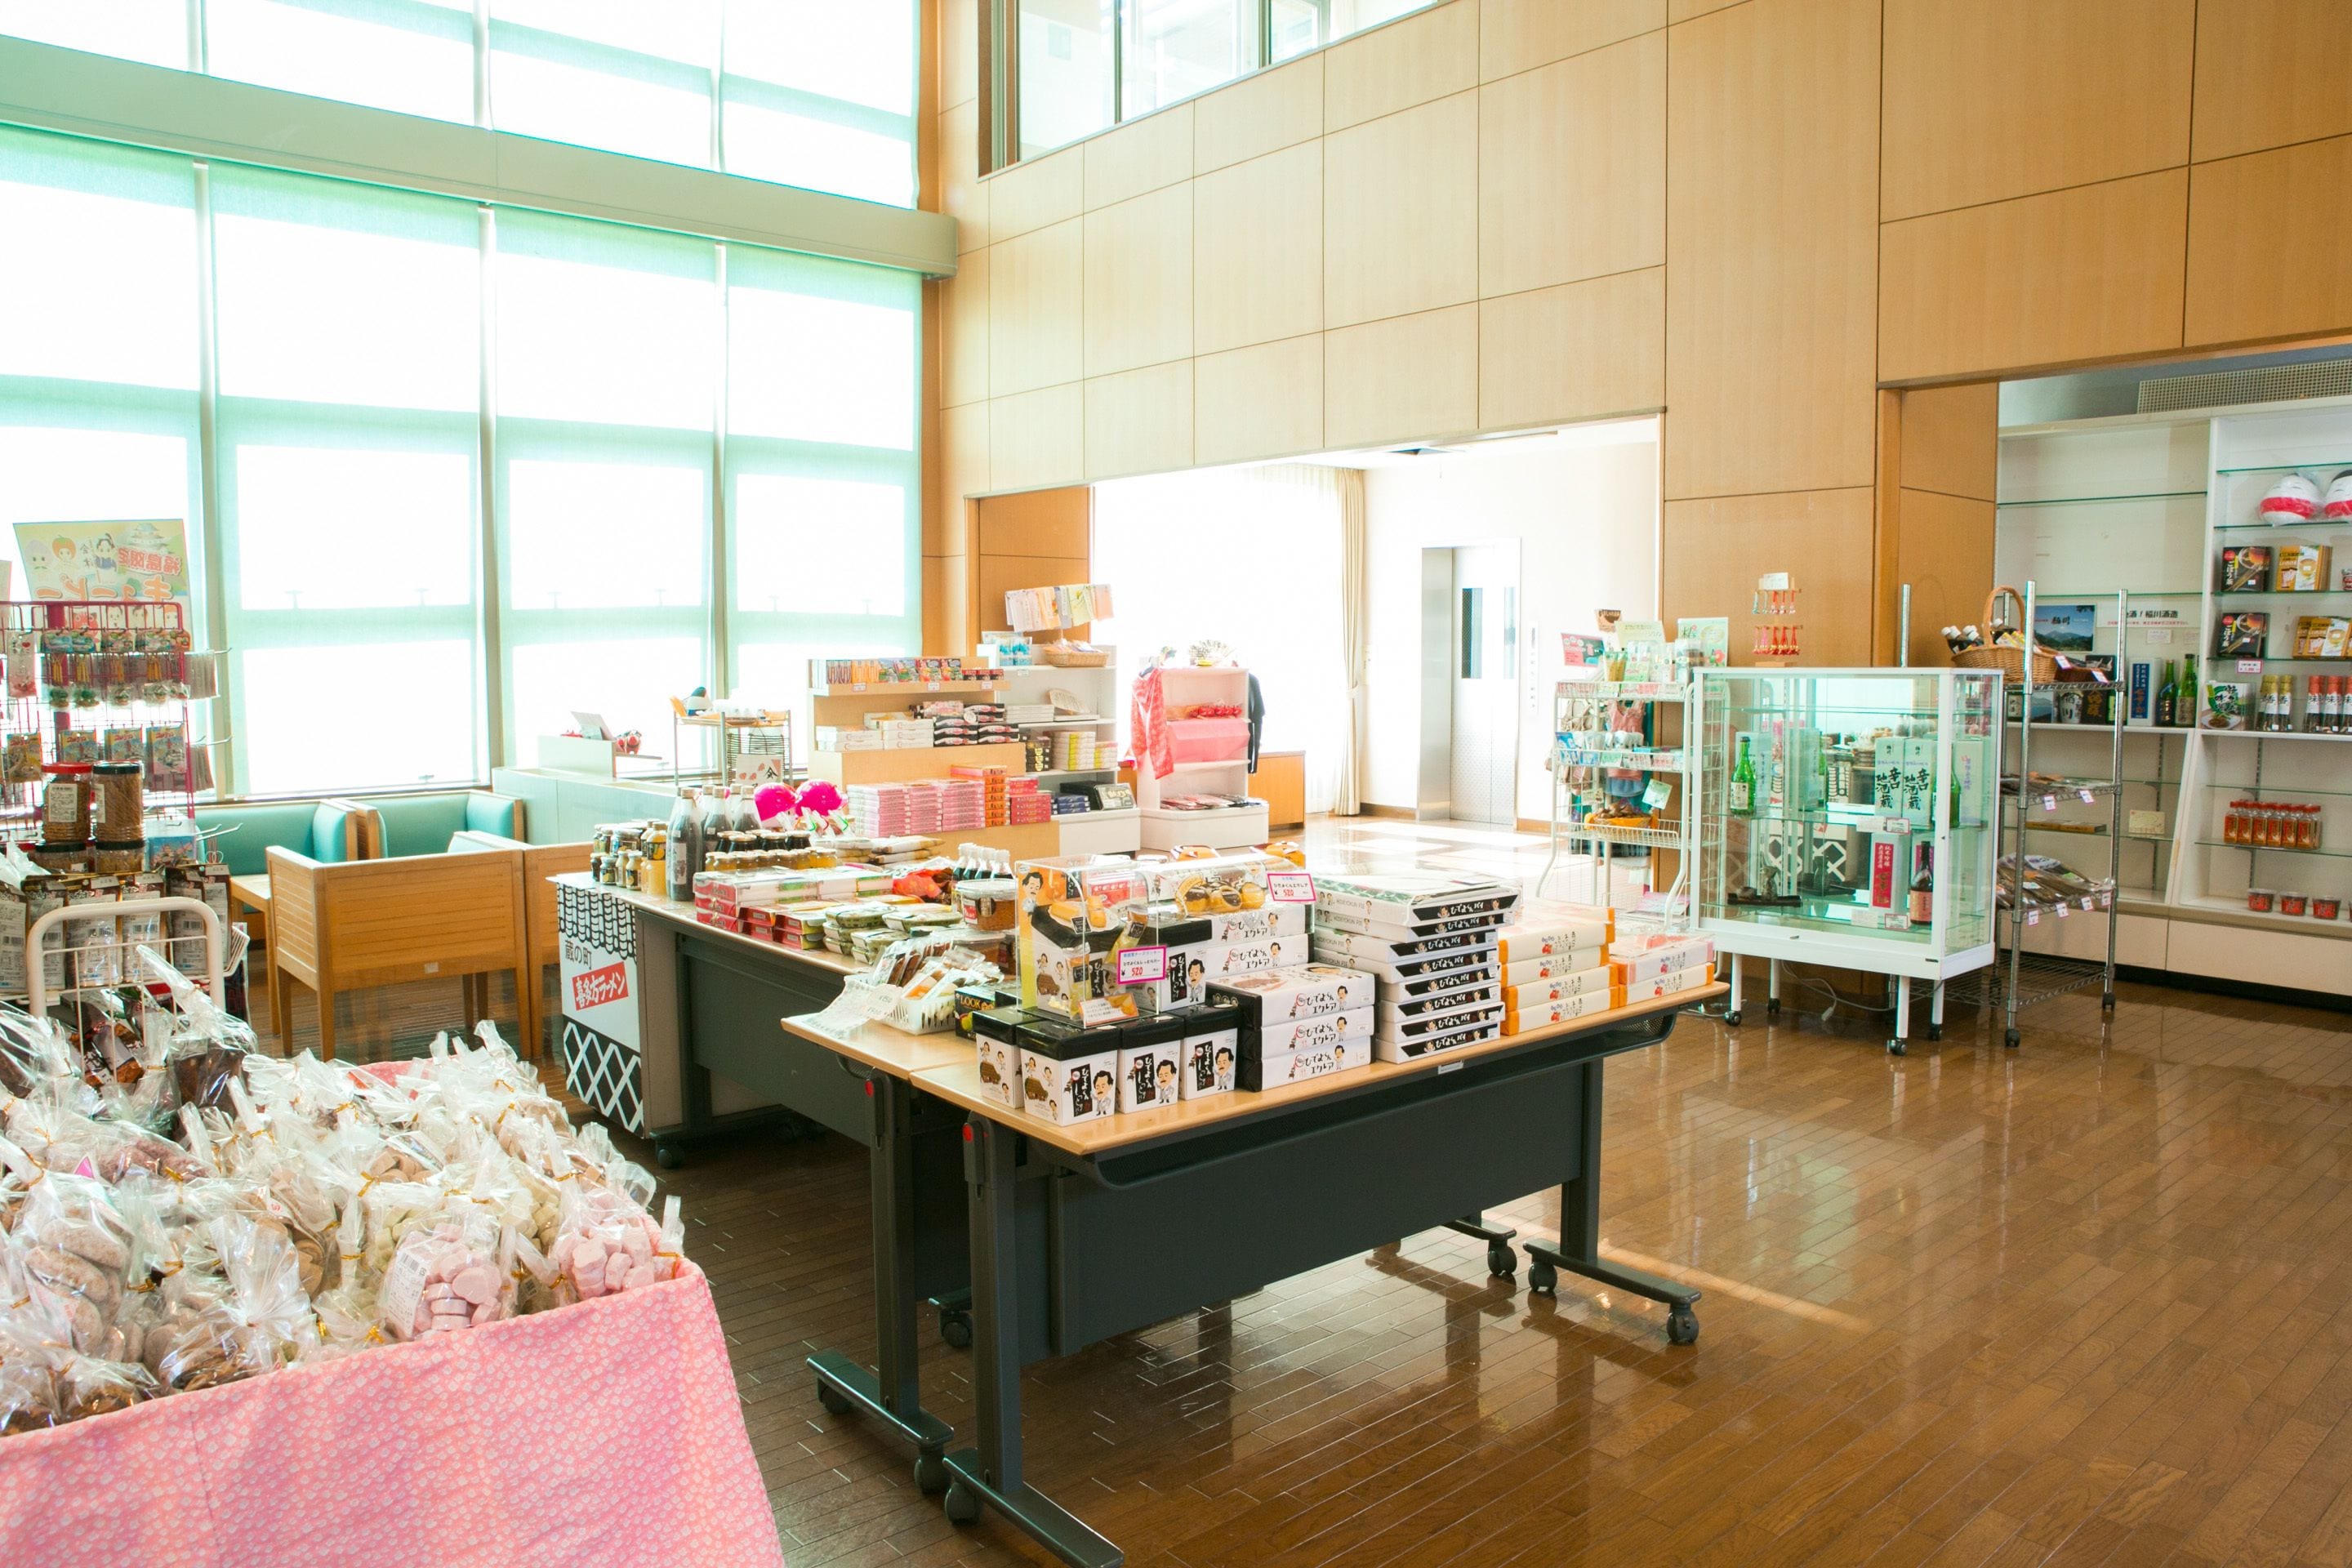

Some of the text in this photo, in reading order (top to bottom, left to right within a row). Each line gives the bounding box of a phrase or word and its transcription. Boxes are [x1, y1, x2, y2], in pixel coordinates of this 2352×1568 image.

[1888, 766, 1901, 790] 辛口
[1917, 768, 1930, 791] 辛口
[1244, 927, 1268, 938] エクレア
[565, 938, 592, 970] 蔵の町
[1246, 958, 1270, 969] エクレア
[1132, 967, 1143, 976] 520
[576, 971, 626, 1009] 喜多方ラーメン
[960, 996, 981, 1009] LOOK
[1312, 1002, 1337, 1013] エクレア
[1312, 1033, 1336, 1045] エクレア
[1311, 1062, 1334, 1074] エクレア
